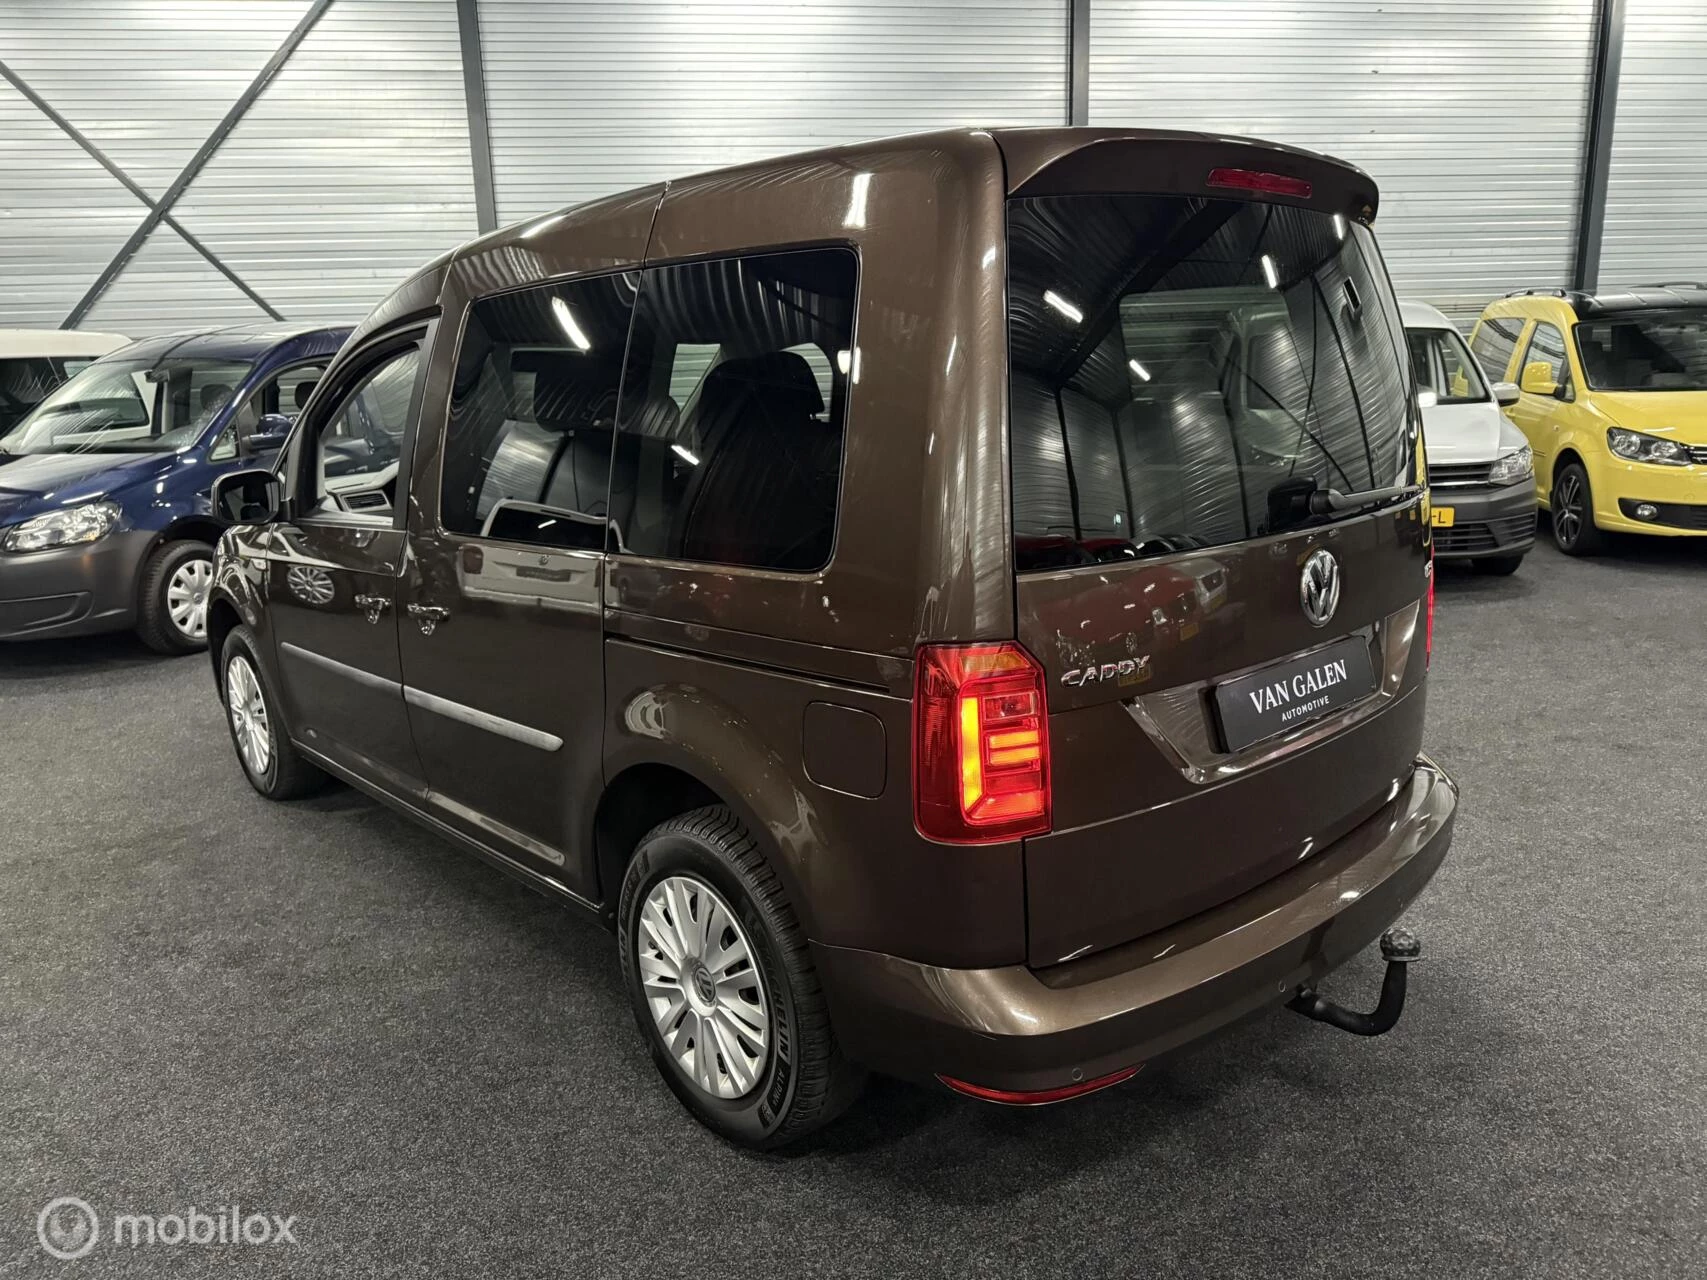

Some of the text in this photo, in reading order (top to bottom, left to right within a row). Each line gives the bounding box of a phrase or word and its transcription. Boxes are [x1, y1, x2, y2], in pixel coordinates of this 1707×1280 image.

[1061, 655, 1151, 687] CADDY
[1249, 659, 1348, 715] VAN GALEN
[1281, 695, 1330, 722] AUTOMOTIVE
